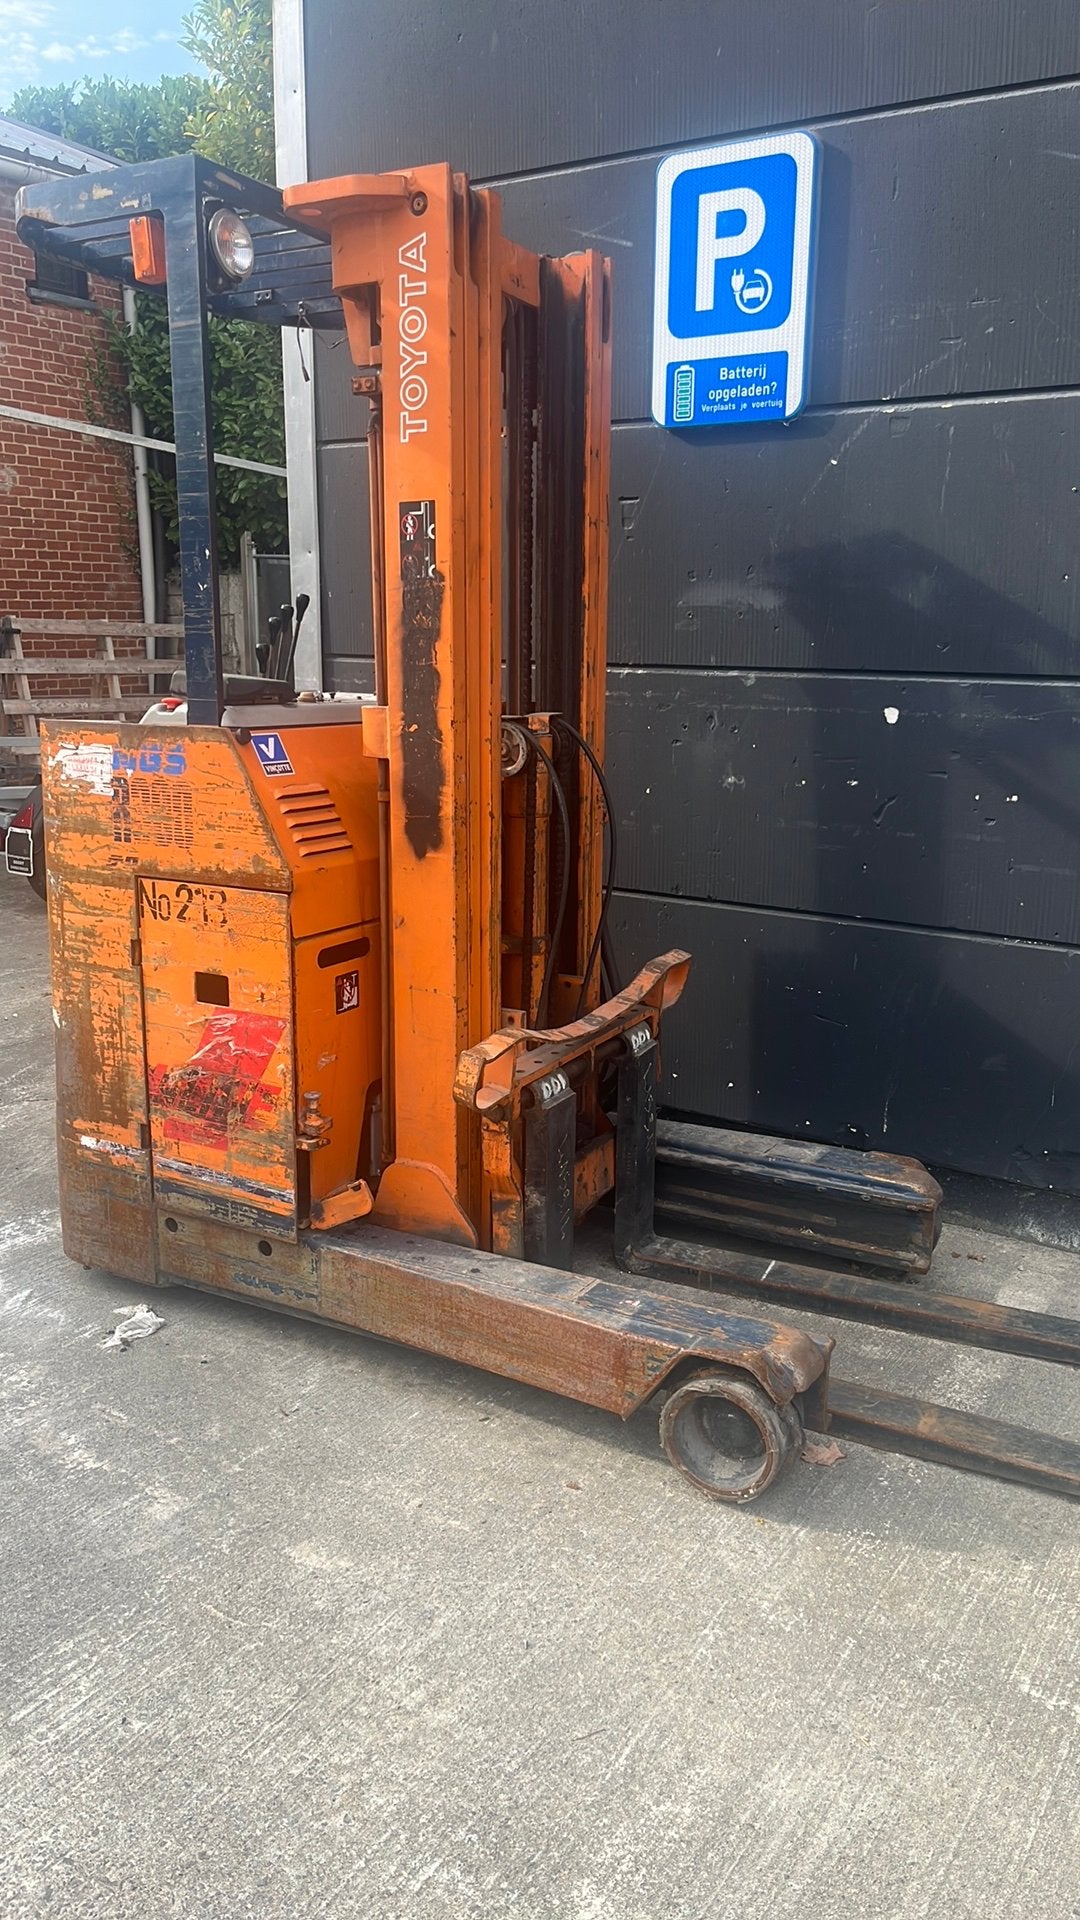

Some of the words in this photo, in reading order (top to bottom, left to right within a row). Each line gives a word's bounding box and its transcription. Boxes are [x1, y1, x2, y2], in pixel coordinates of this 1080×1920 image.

[695, 187, 766, 312] P
[399, 232, 428, 443] TOYOTA
[719, 364, 767, 381] Batterij
[708, 381, 778, 402] opgeladen?
[701, 402, 736, 413] Verplaats
[740, 402, 748, 411] je
[751, 399, 783, 409] voertuig
